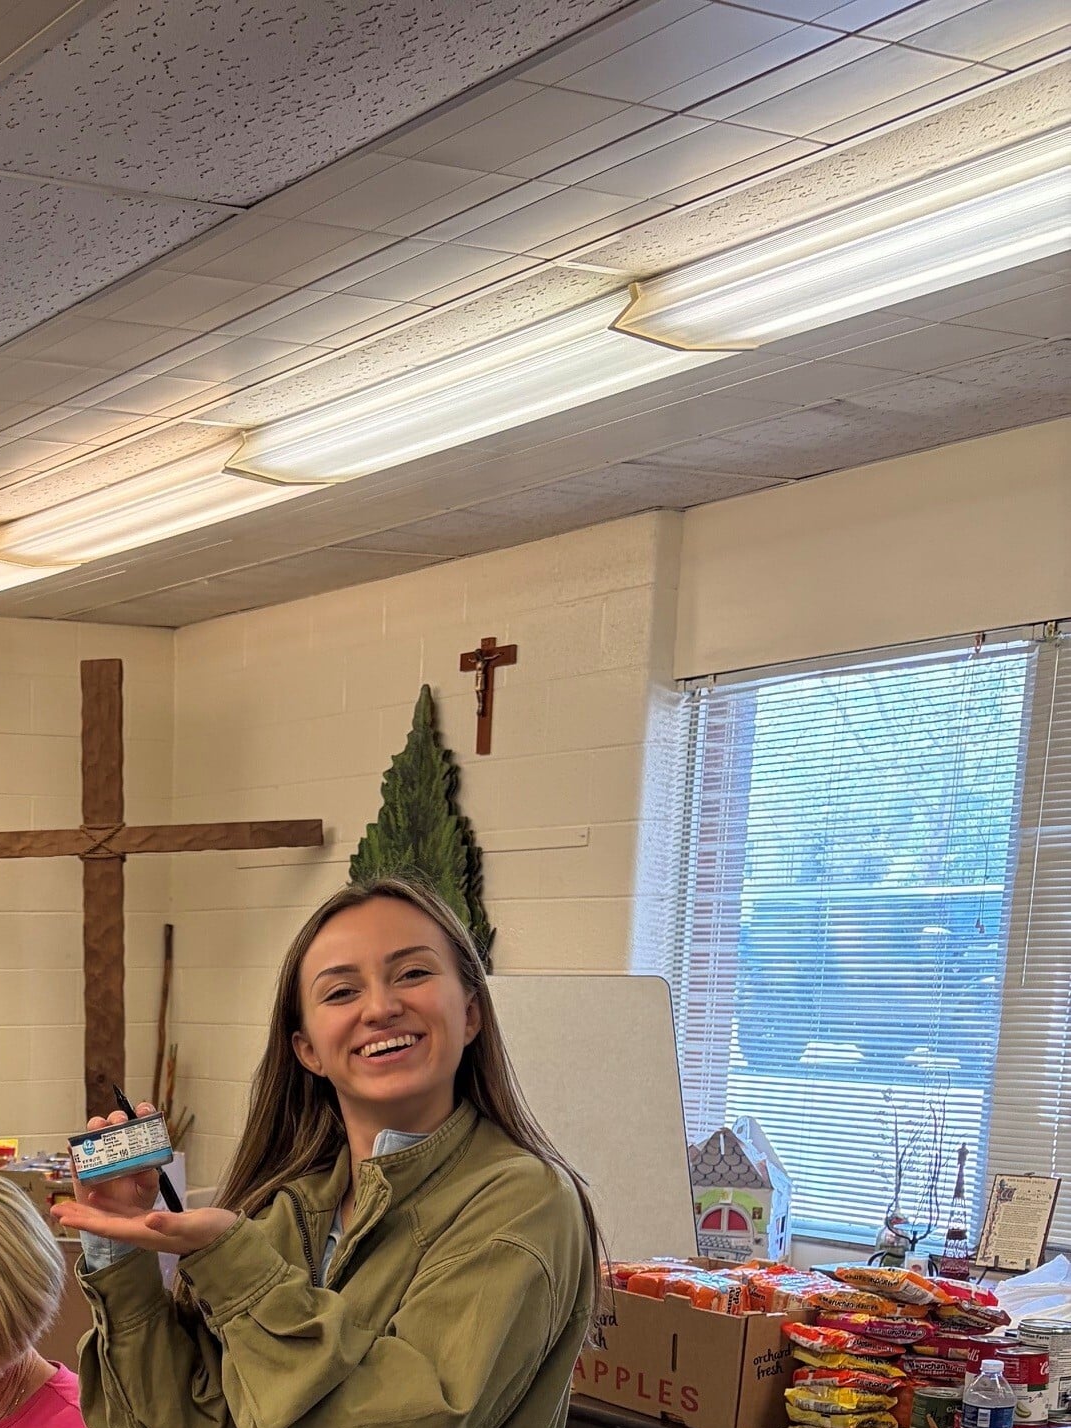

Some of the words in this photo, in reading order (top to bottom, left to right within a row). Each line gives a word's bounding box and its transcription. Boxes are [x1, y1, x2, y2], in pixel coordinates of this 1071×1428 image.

[753, 1343, 793, 1365] orchard
[756, 1360, 784, 1380] fresh
[575, 1355, 699, 1412] APPLES
